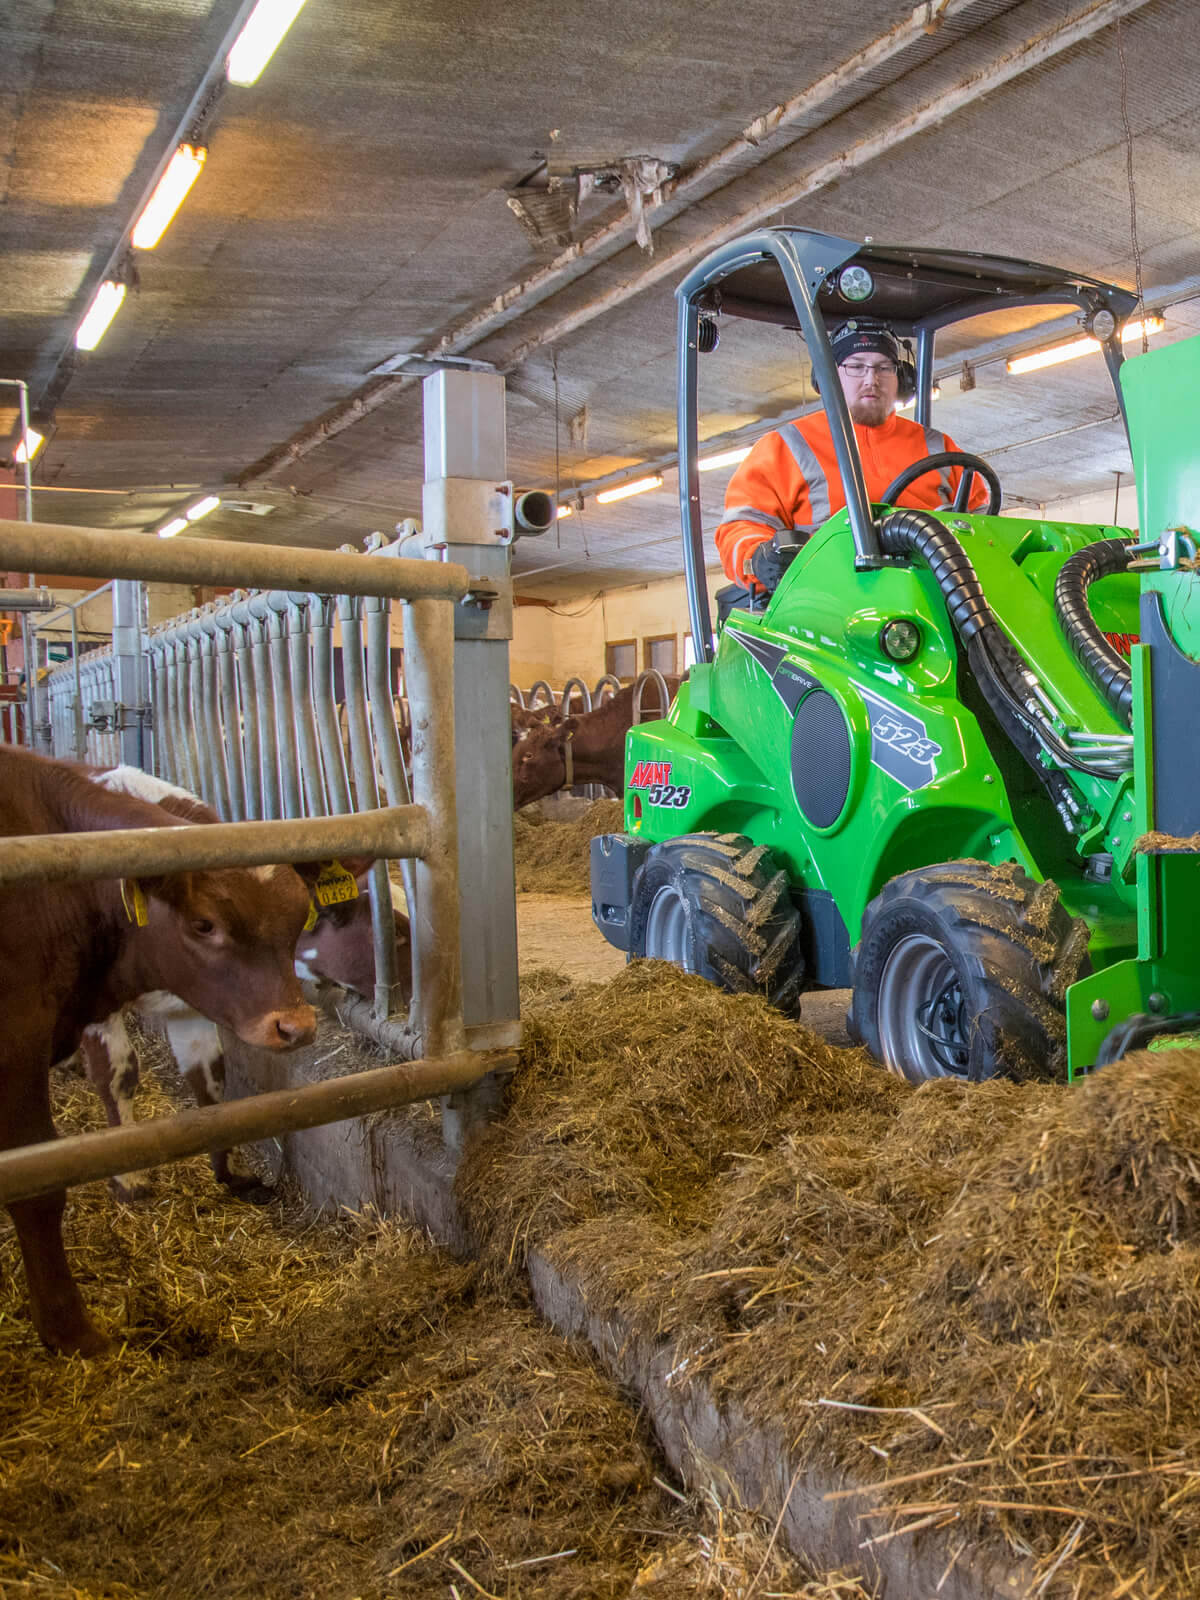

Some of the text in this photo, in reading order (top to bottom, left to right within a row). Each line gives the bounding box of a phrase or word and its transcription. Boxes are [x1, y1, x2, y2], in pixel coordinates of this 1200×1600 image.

[872, 714, 943, 765] 523
[629, 761, 672, 787] AVANT
[649, 784, 692, 810] 523
[322, 887, 353, 904] 0452
